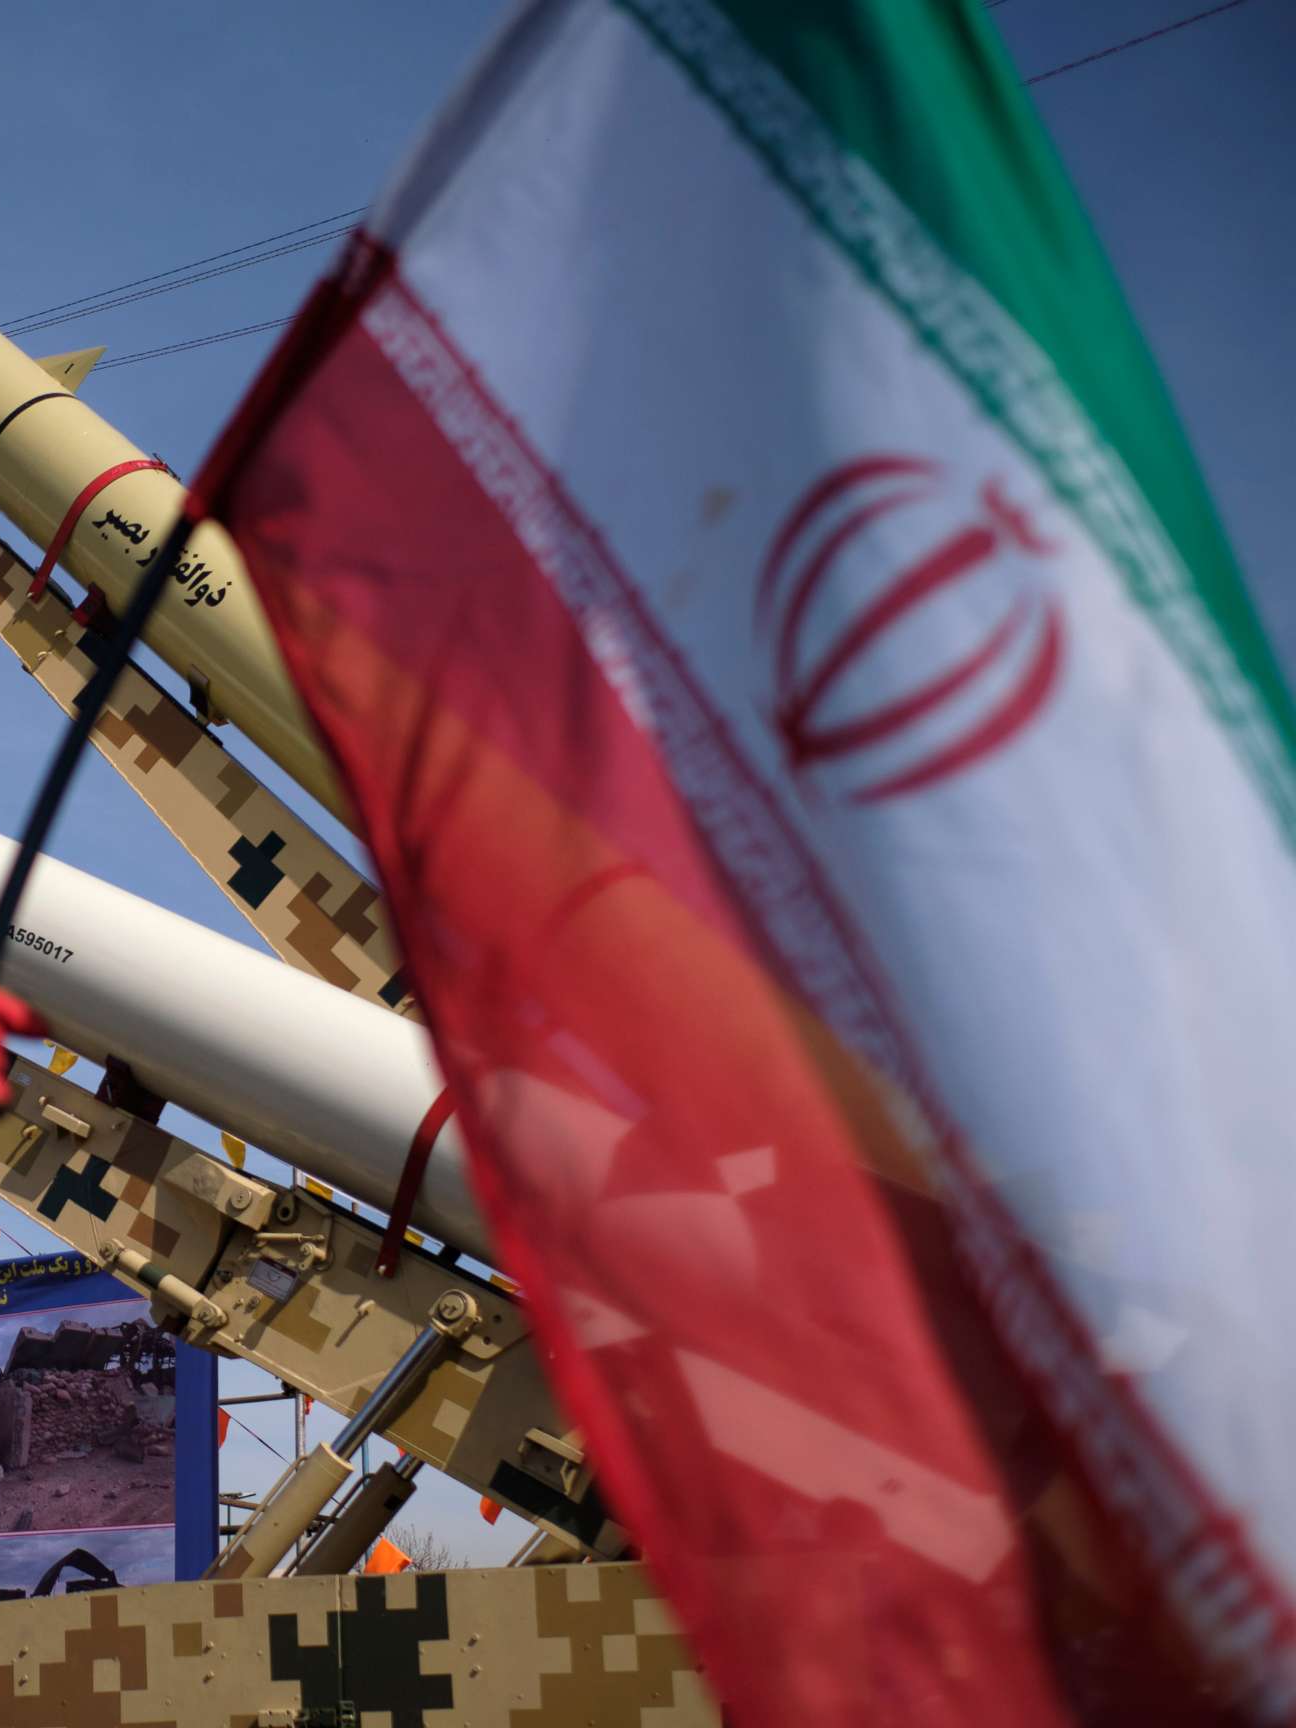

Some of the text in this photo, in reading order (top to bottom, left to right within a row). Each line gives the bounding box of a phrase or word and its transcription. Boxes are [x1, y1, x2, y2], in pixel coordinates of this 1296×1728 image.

[91, 508, 151, 554] بصیر
[20, 1258, 45, 1278] ملت
[48, 1255, 68, 1276] یک
[73, 1259, 81, 1276] و
